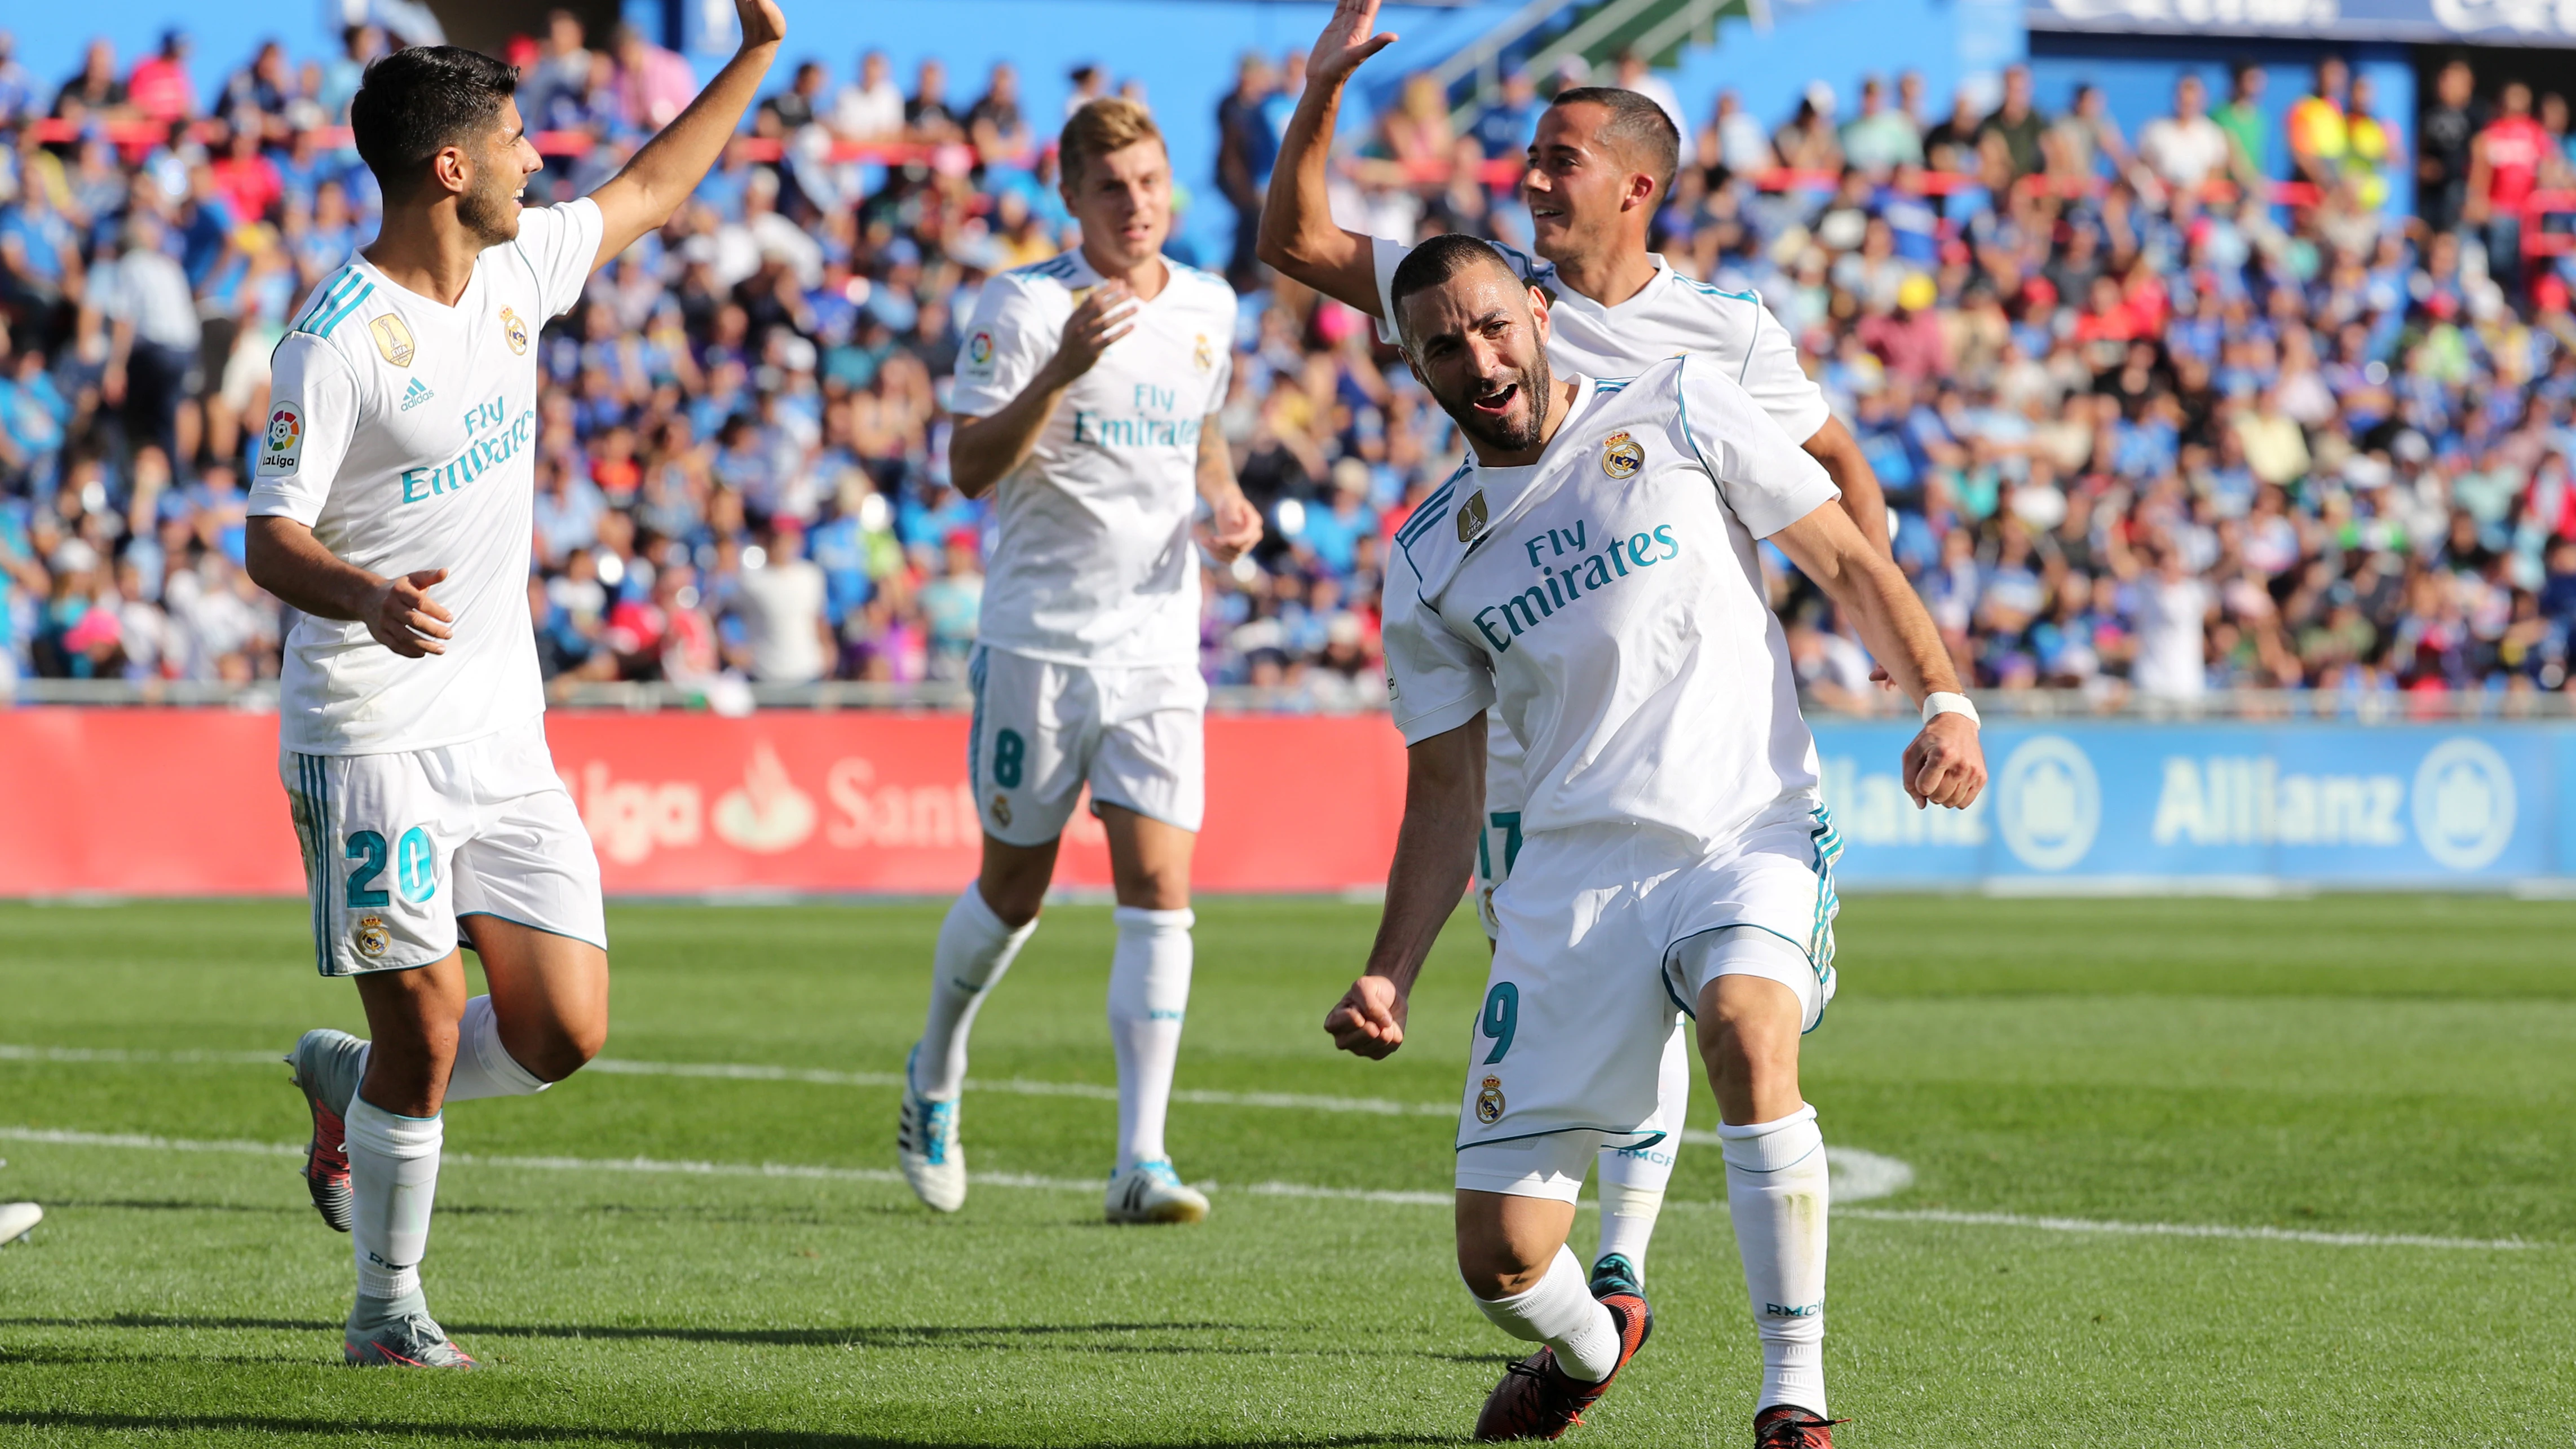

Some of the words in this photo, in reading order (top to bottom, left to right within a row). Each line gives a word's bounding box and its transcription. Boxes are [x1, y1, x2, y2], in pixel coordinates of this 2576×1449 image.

[391, 345, 408, 357] FIFA
[400, 390, 434, 412] adidas
[463, 396, 503, 438] Fly
[1134, 383, 1174, 412] Fly
[1074, 411, 1202, 447] Emirate
[262, 454, 294, 468] LaLiga
[1525, 519, 1587, 568] Fly
[1473, 524, 1679, 652] Emirates
[994, 728, 1024, 788] 8
[2153, 756, 2405, 845] Allianz
[345, 827, 435, 908] 20
[1482, 982, 1519, 1065] 9
